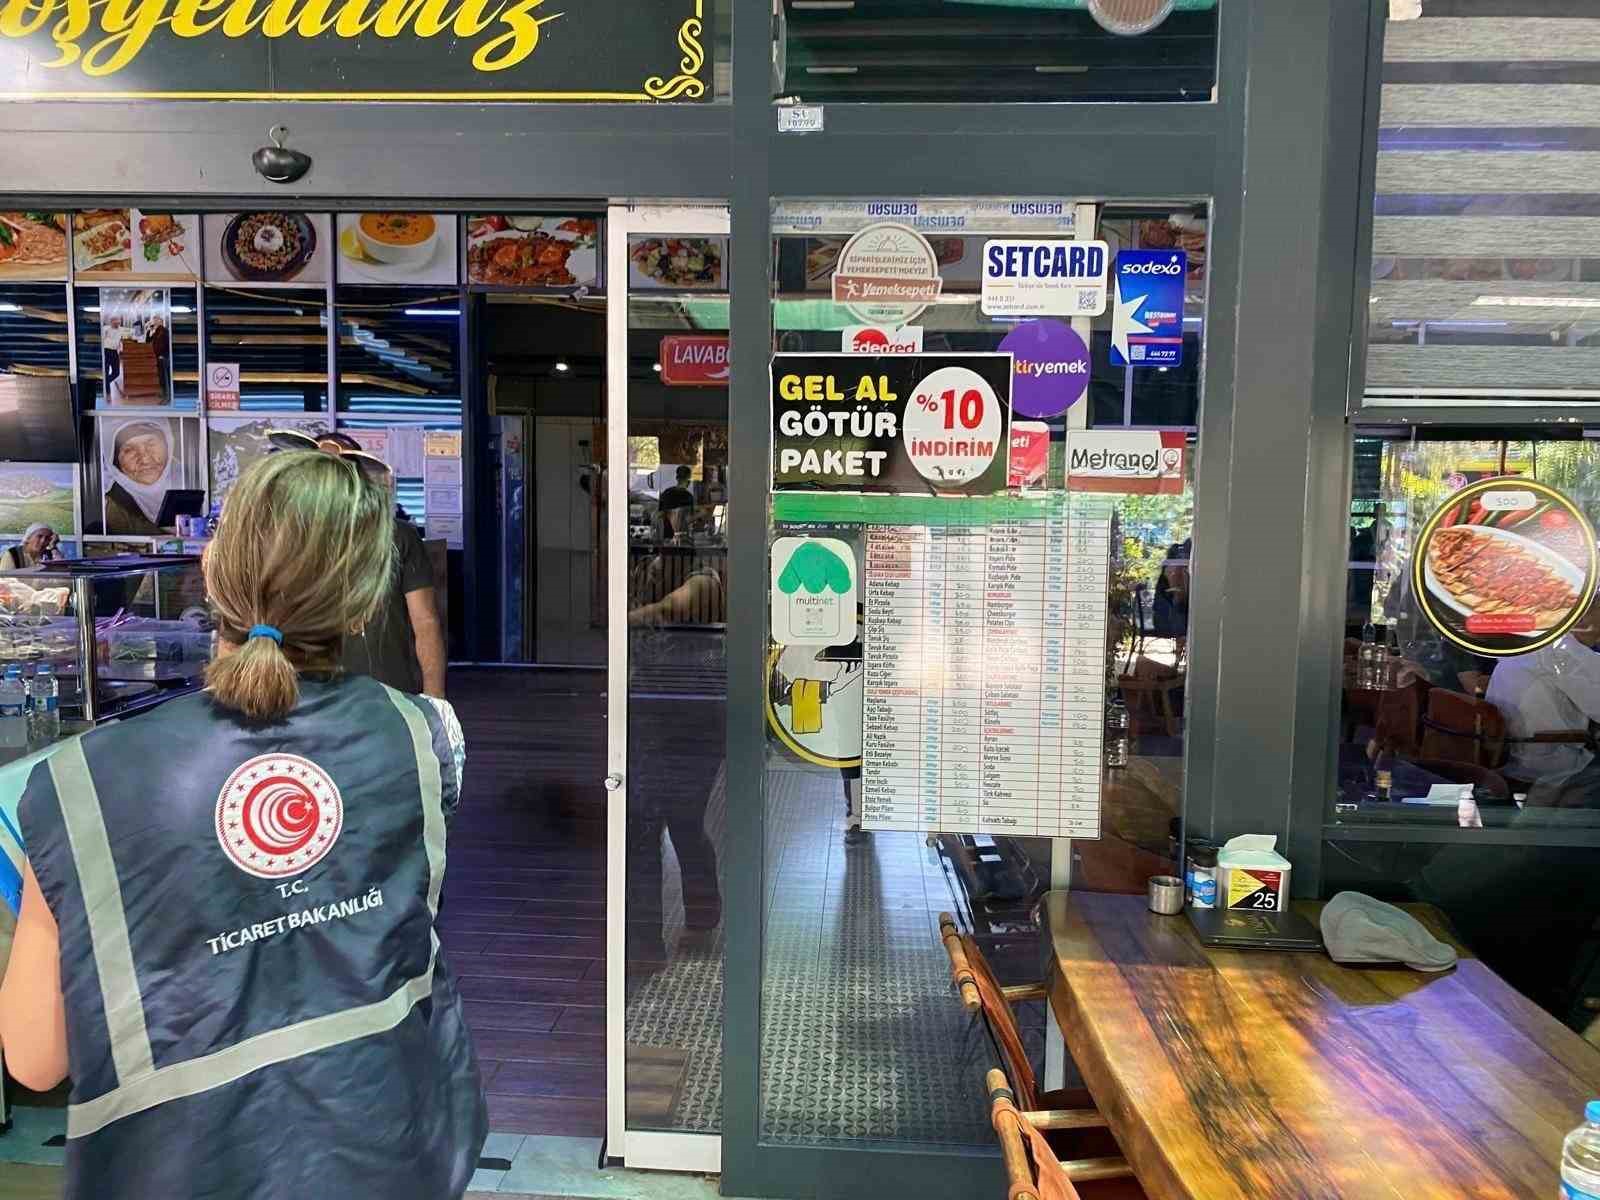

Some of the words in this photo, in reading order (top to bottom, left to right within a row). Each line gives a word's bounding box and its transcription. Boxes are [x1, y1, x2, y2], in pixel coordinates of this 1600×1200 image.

[988, 245, 1104, 279] SETCARD
[1121, 257, 1181, 275] sodexo
[862, 281, 936, 298] Yemeksepeti
[852, 339, 916, 354] Edenred
[1014, 359, 1087, 378] tiryemek
[779, 374, 845, 402] GEL
[855, 375, 898, 402] AL
[916, 389, 985, 431] %10
[779, 405, 898, 438] GÖTÜR
[911, 437, 994, 457] İNDİRİM
[780, 448, 888, 478] PAKET
[795, 596, 834, 606] multinet
[274, 879, 310, 899] T.C.
[1252, 892, 1276, 909] 25
[205, 915, 287, 955] TİCARET
[287, 886, 384, 930] BAKANLIĞI
